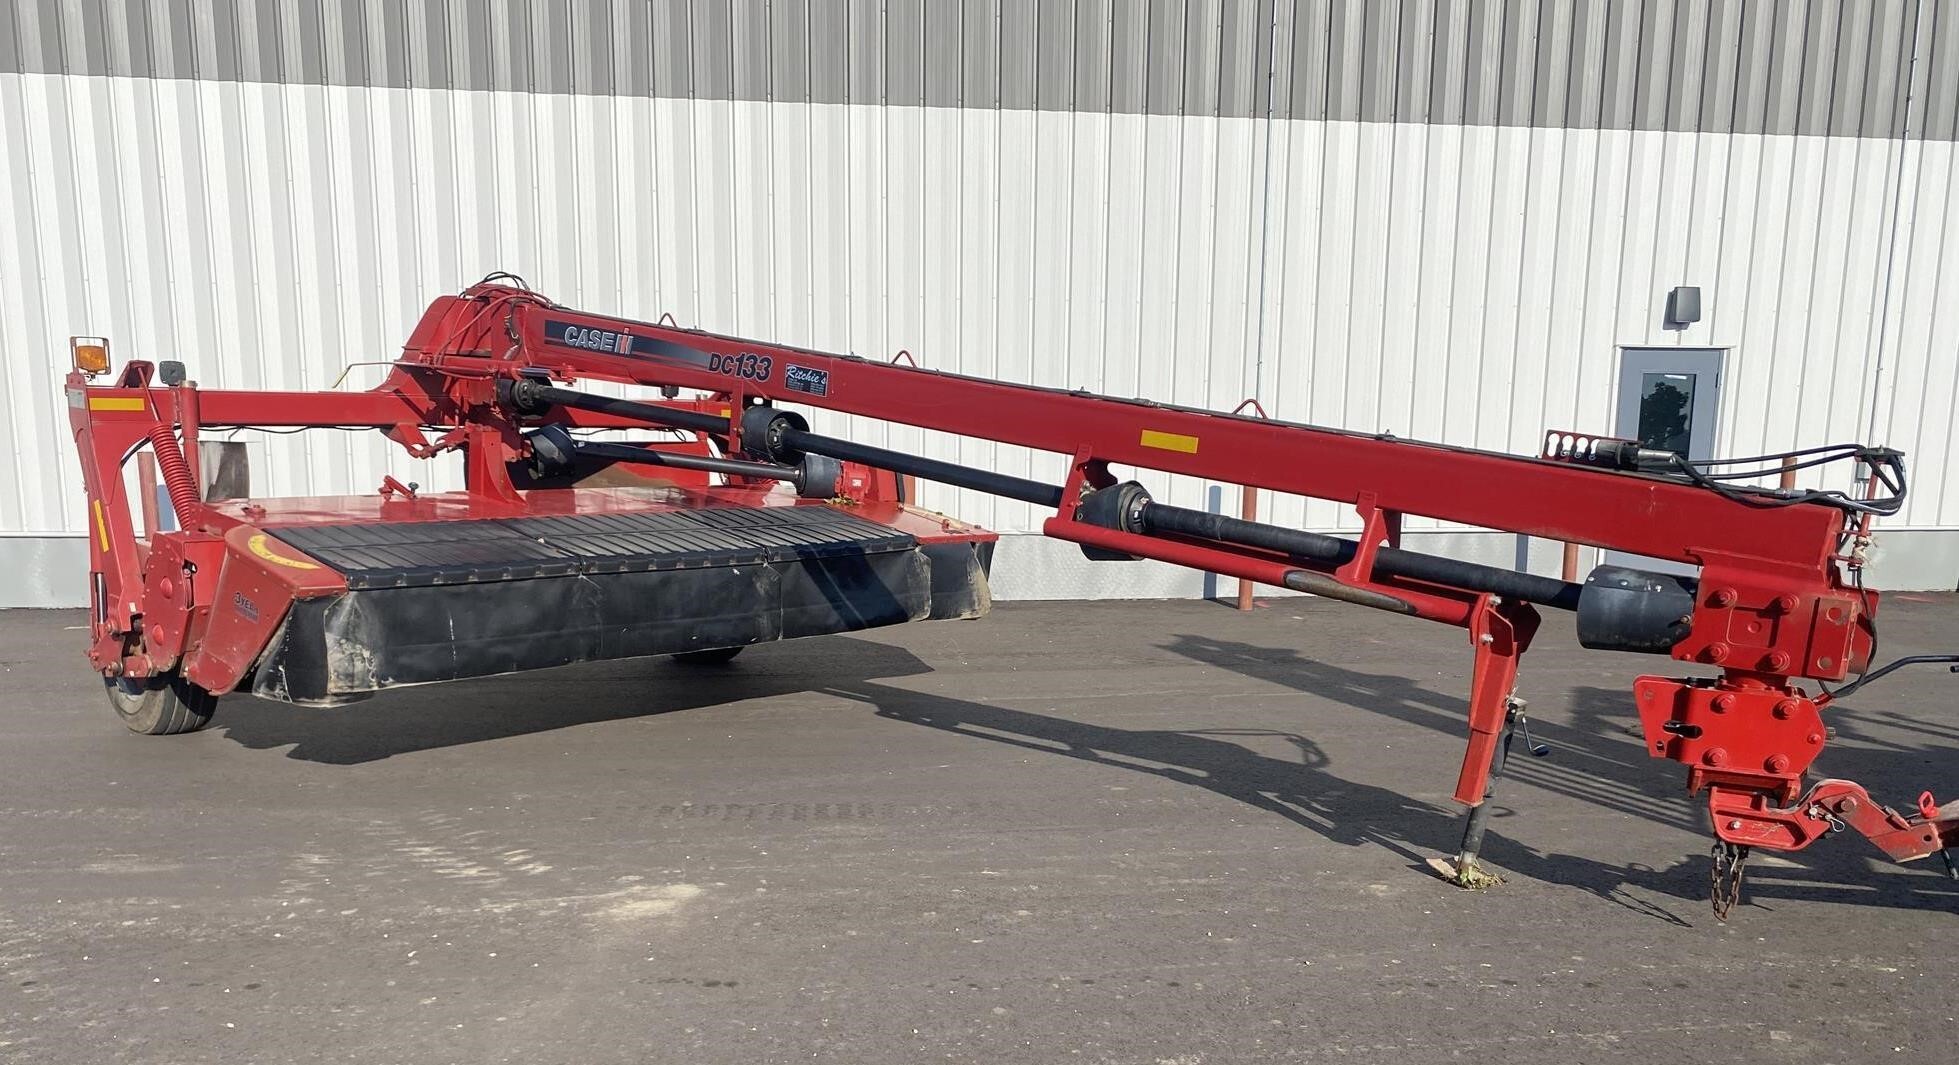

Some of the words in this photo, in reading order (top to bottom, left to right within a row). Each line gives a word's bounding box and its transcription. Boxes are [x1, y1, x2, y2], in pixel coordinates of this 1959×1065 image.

[565, 326, 615, 352] CASE
[708, 352, 773, 382] DC133
[786, 365, 826, 385] Ritchie's
